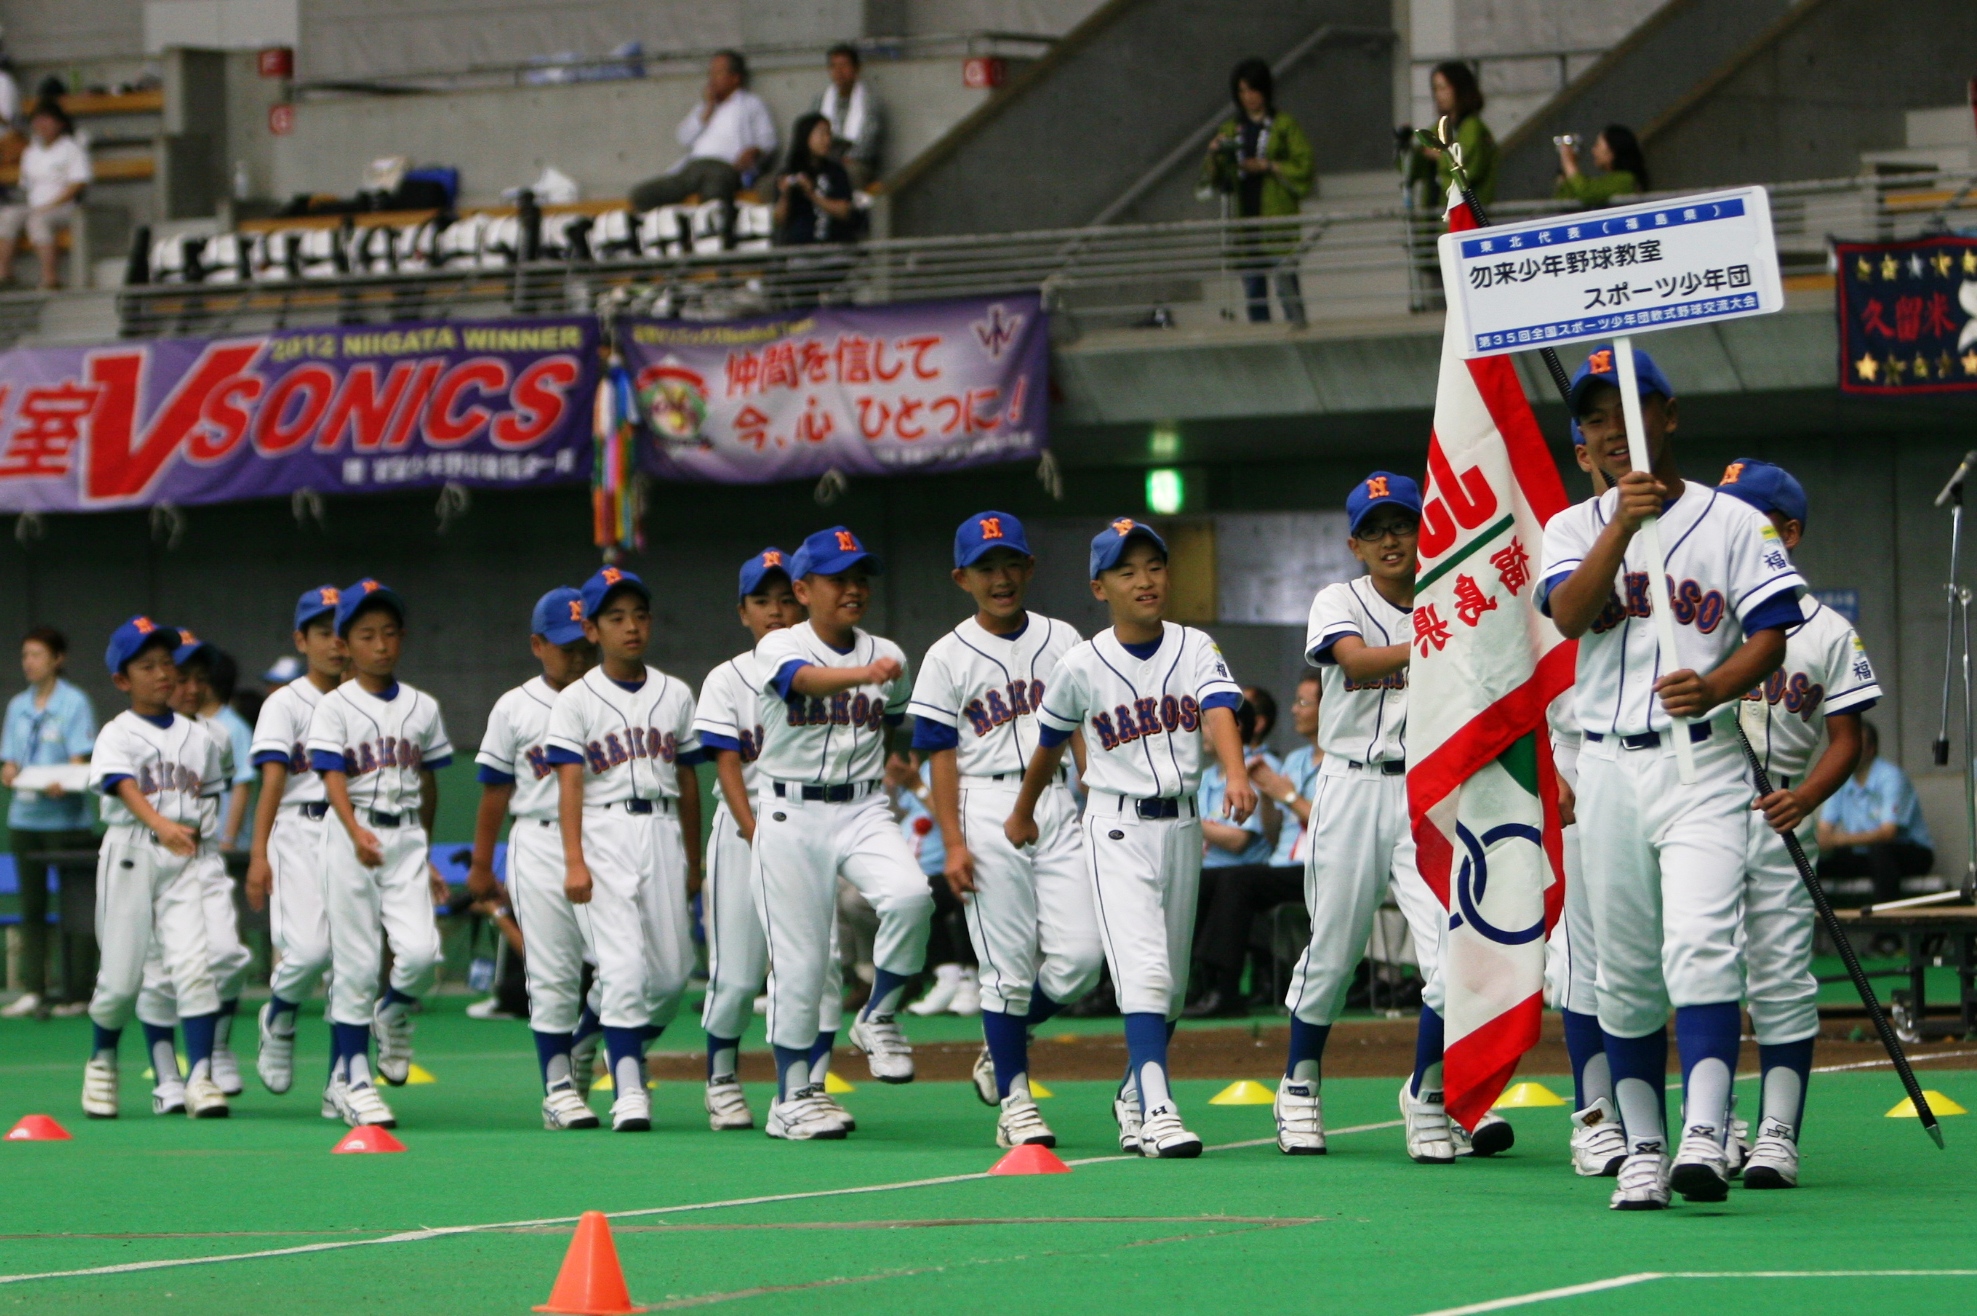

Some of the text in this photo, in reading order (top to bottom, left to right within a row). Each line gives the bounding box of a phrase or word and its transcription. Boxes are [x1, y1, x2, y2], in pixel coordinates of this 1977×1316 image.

[1469, 240, 1663, 290] 勿来少年野球教室
[1584, 264, 1751, 310] スポーツ少年団
[1861, 291, 1957, 341] 久留米
[271, 326, 582, 362] 2012 NIIGATA WINNER
[725, 335, 942, 397] 仲間を信じて
[1588, 349, 1613, 375] N
[1366, 476, 1390, 500] N
[979, 518, 1004, 540] N
[1112, 518, 1135, 537] N
[835, 531, 858, 551] N
[762, 550, 783, 568] N
[1763, 550, 1787, 572] 福
[602, 567, 623, 586] N
[1853, 660, 1872, 681] 福
